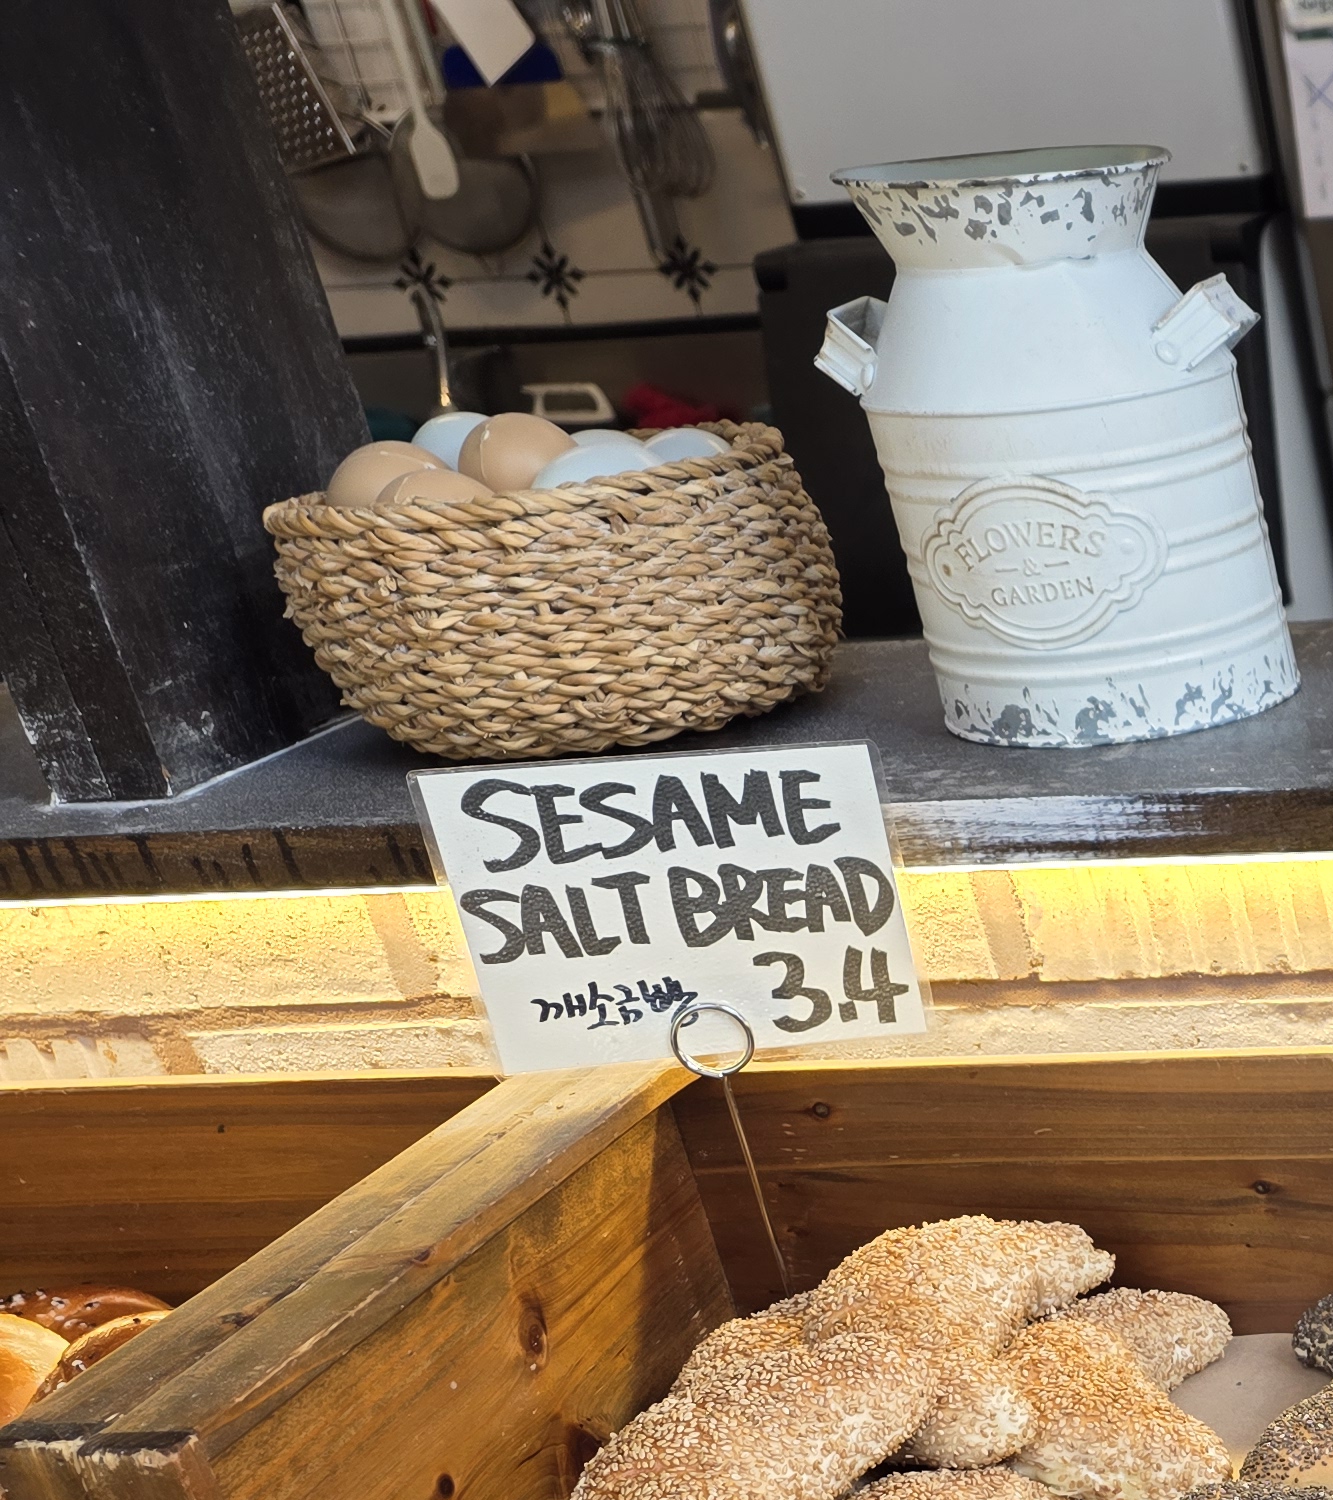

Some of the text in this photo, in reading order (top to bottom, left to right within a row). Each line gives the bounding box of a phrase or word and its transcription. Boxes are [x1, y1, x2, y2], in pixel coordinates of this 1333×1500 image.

[953, 520, 1106, 571] FLOWERS
[1023, 557, 1041, 577] &
[990, 576, 1095, 608] GARDEN
[461, 768, 841, 873] SESAME
[459, 856, 896, 965] SALT BREAD
[752, 945, 910, 1034] 3.4
